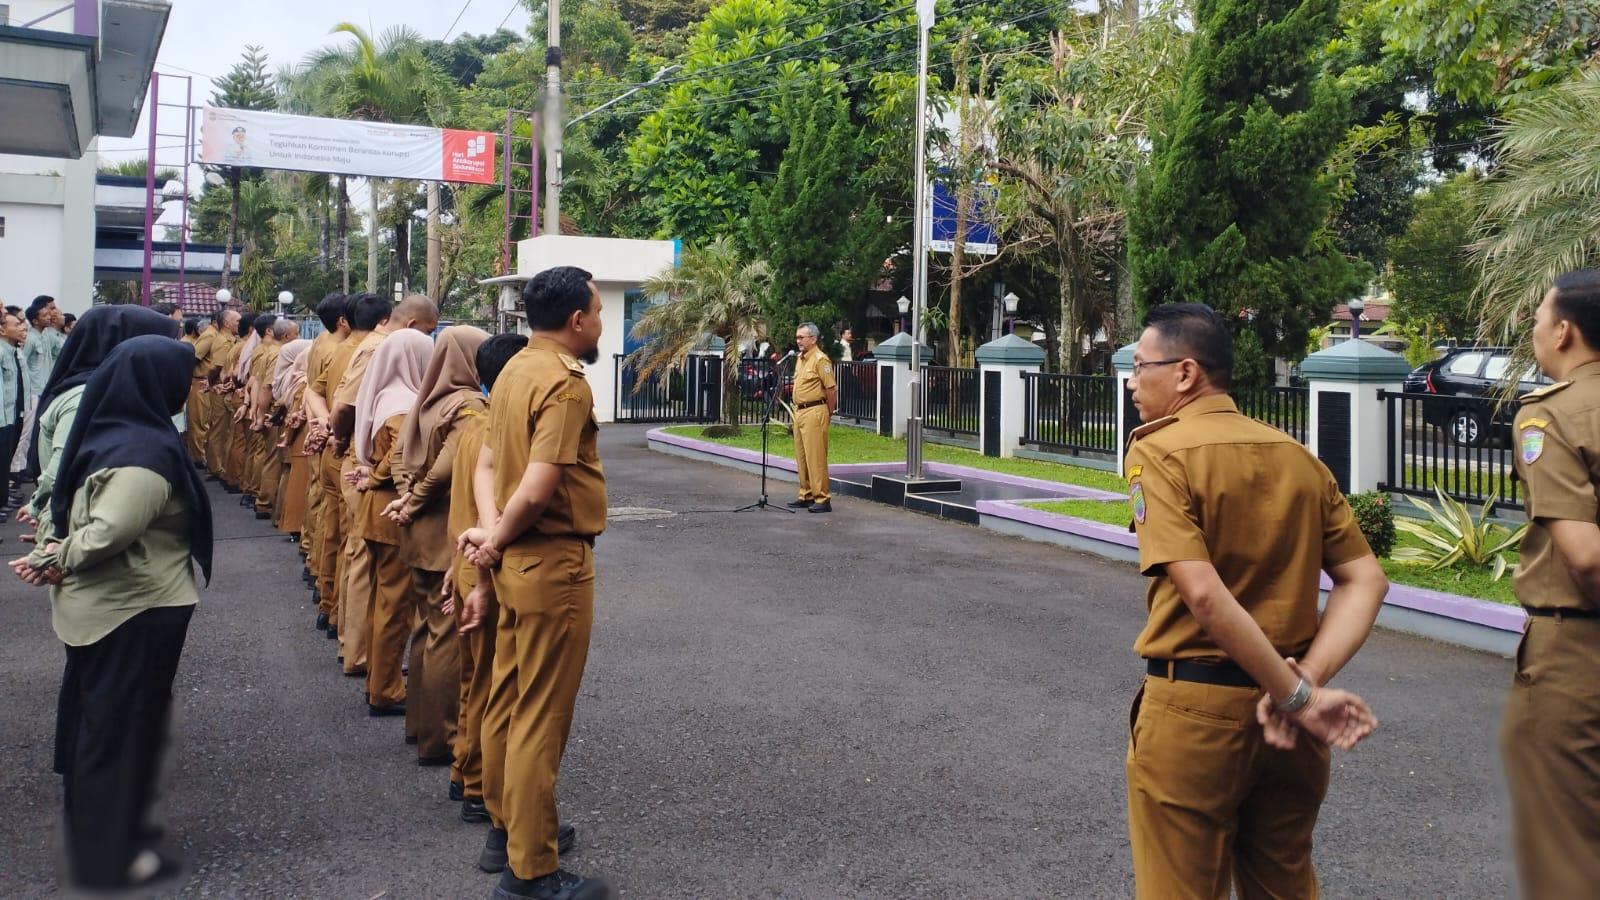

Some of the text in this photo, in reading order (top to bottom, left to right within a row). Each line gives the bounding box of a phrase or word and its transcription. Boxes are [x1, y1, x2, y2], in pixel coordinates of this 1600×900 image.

[269, 139, 307, 149] Teguhkan
[308, 143, 347, 153] Komitmen
[295, 153, 331, 161] Indonesia
